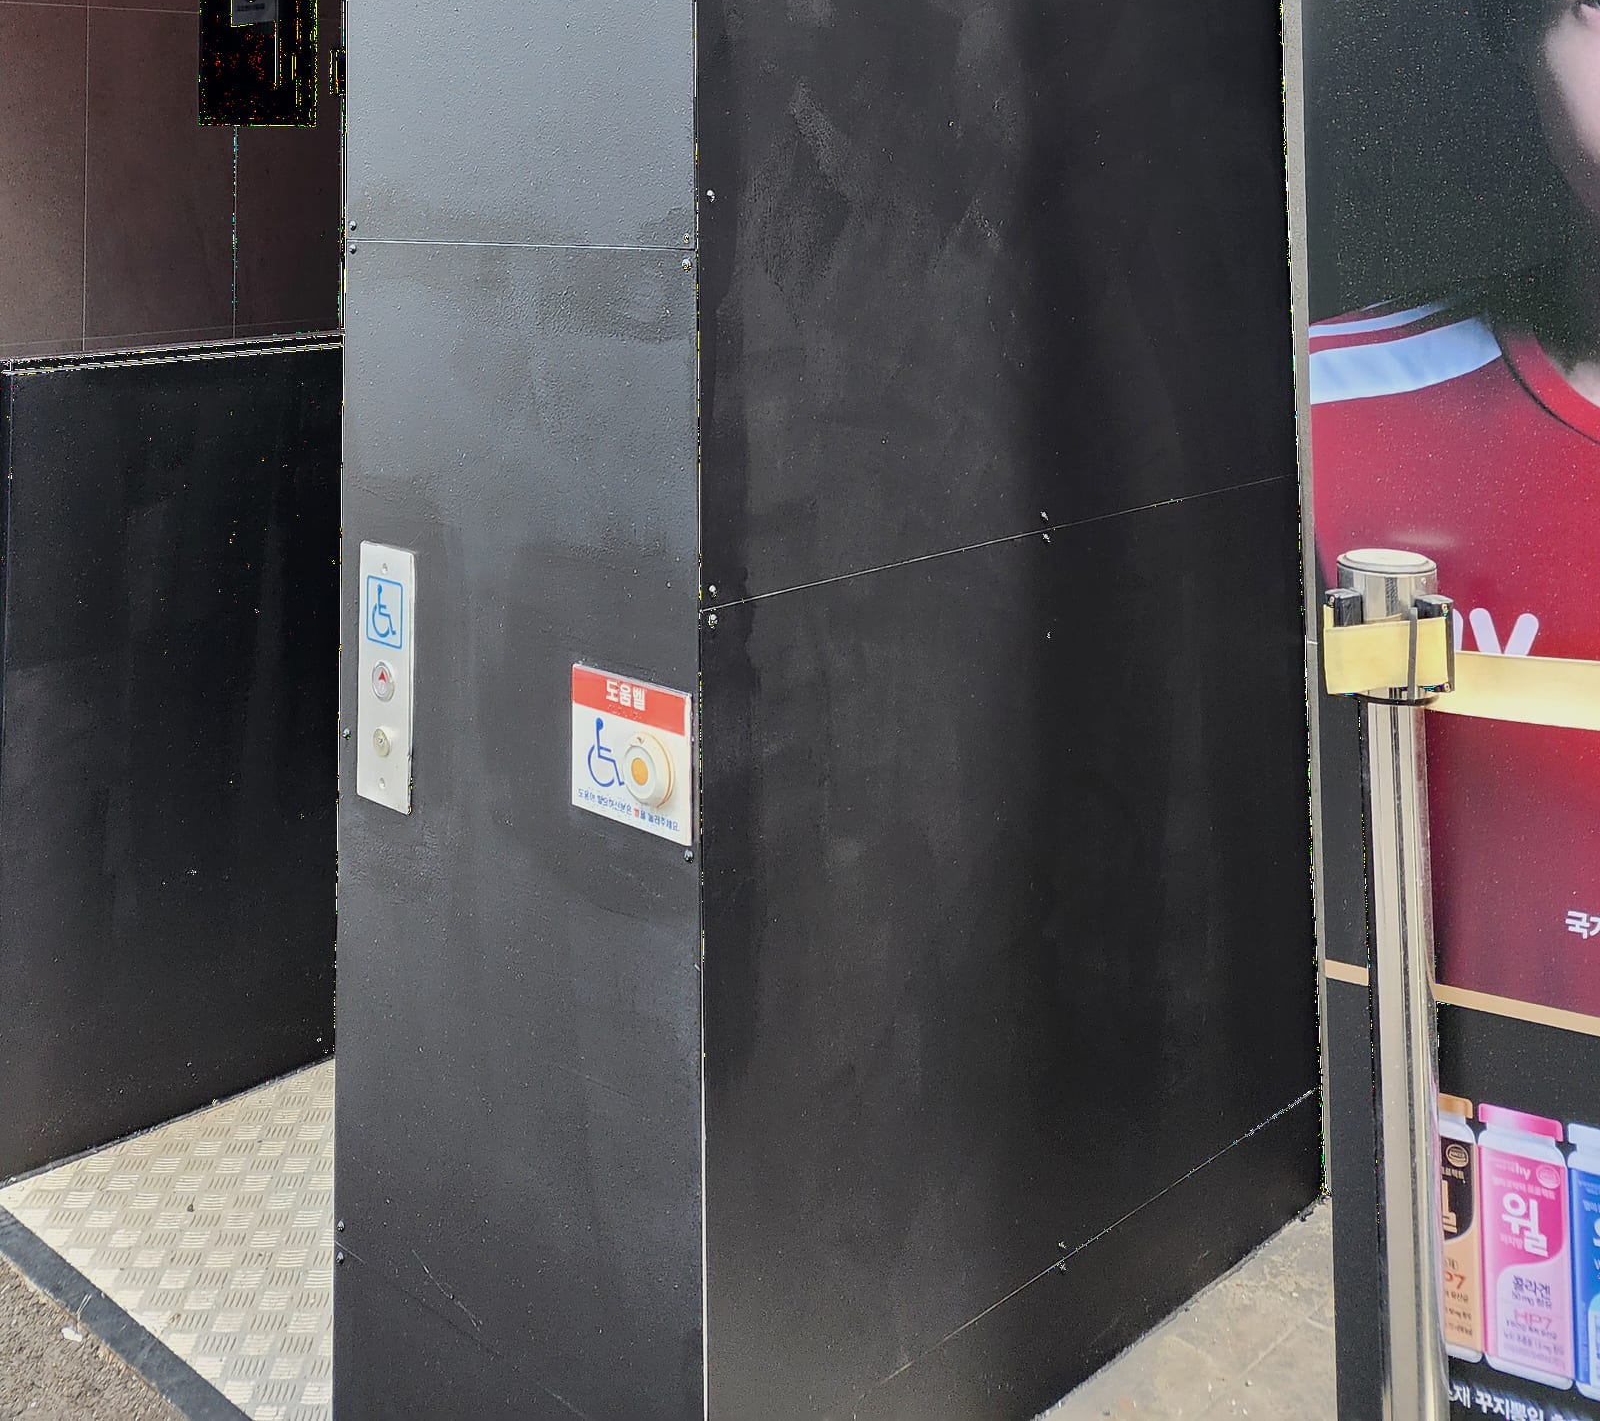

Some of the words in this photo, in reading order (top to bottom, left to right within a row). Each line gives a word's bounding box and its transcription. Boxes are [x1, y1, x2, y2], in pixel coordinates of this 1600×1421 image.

[605, 680, 647, 711] 도움벨
[578, 788, 595, 800] 도움이
[1513, 1309, 1552, 1330] HP7
